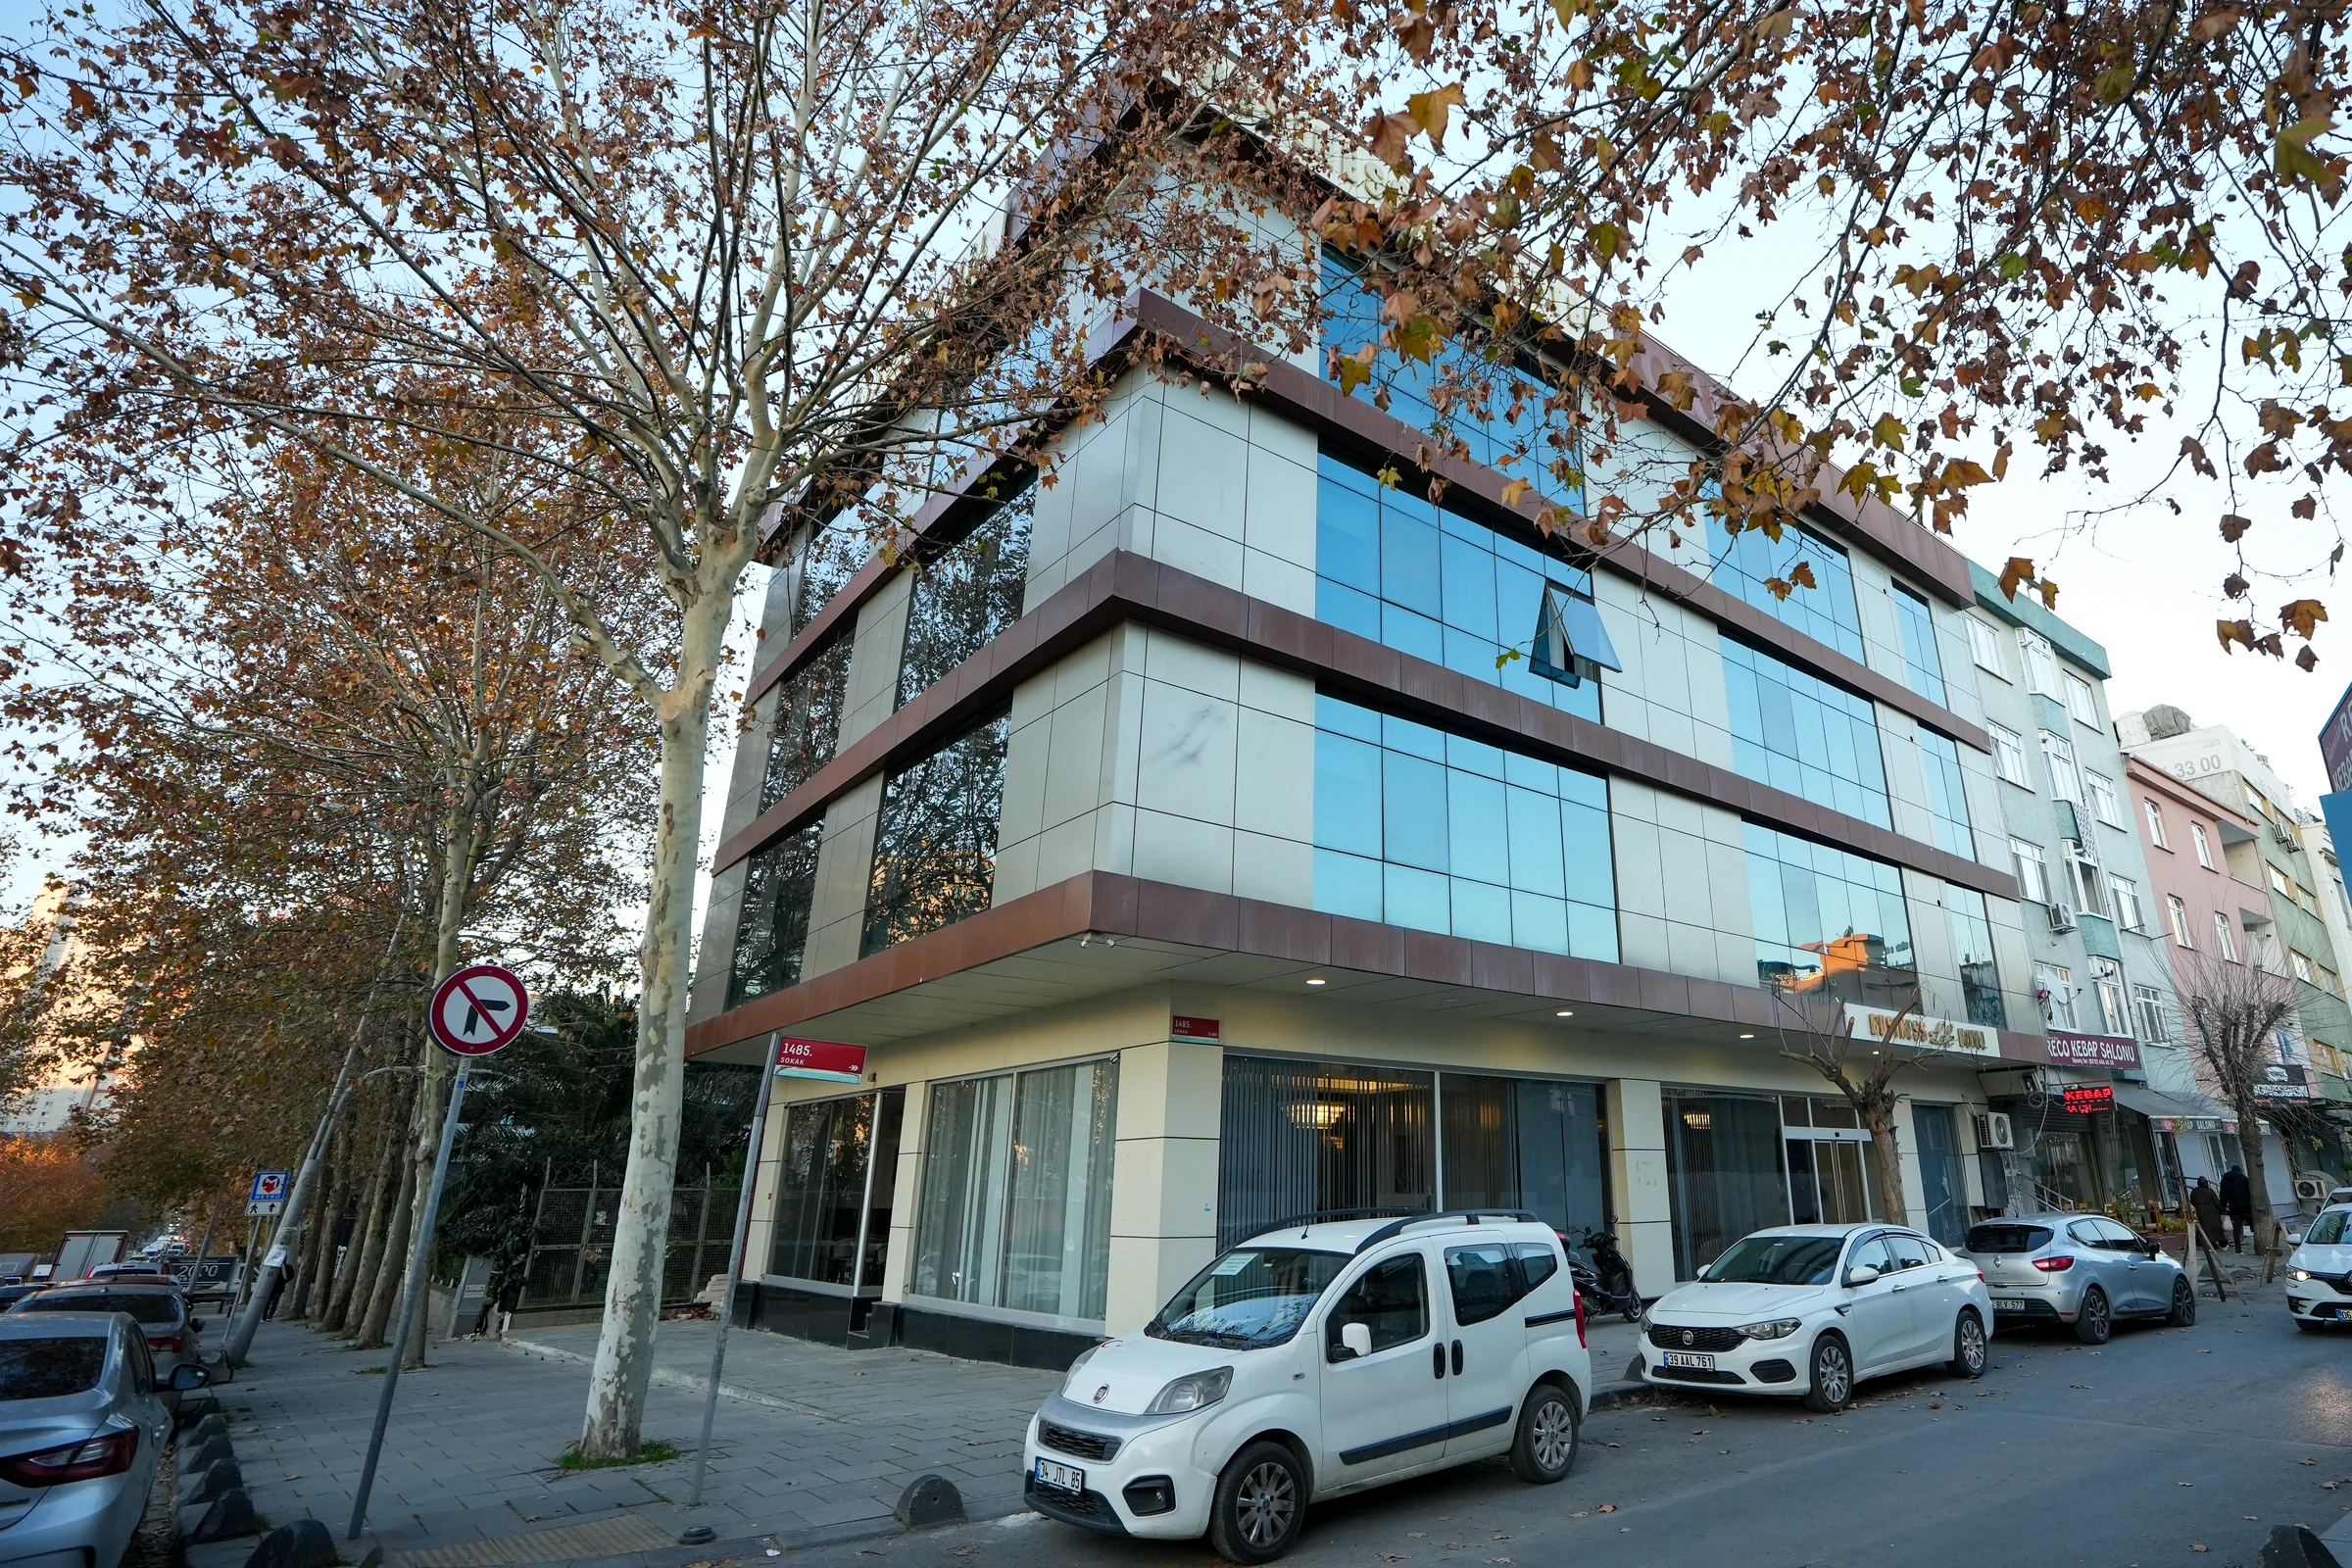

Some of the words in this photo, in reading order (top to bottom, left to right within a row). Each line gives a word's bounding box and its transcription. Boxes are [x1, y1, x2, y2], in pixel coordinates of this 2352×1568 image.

[2175, 760, 2195, 778] 33
[2200, 754, 2222, 772] 00
[782, 1043, 812, 1056] 1485.
[2071, 1040, 2098, 1057] KEBAP
[2099, 1042, 2135, 1062] SALONU
[780, 1056, 805, 1065] SOKAK
[2063, 1087, 2112, 1100] KEBAP
[2196, 1120, 2216, 1130] SALONU
[2011, 1300, 2024, 1309] 577
[1669, 1354, 1679, 1365] 39
[1681, 1355, 1695, 1367] AAL
[1696, 1356, 1712, 1368] 761
[1041, 1461, 1049, 1479] 34
[1053, 1466, 1066, 1485] JTL
[1070, 1471, 1081, 1489] 85
